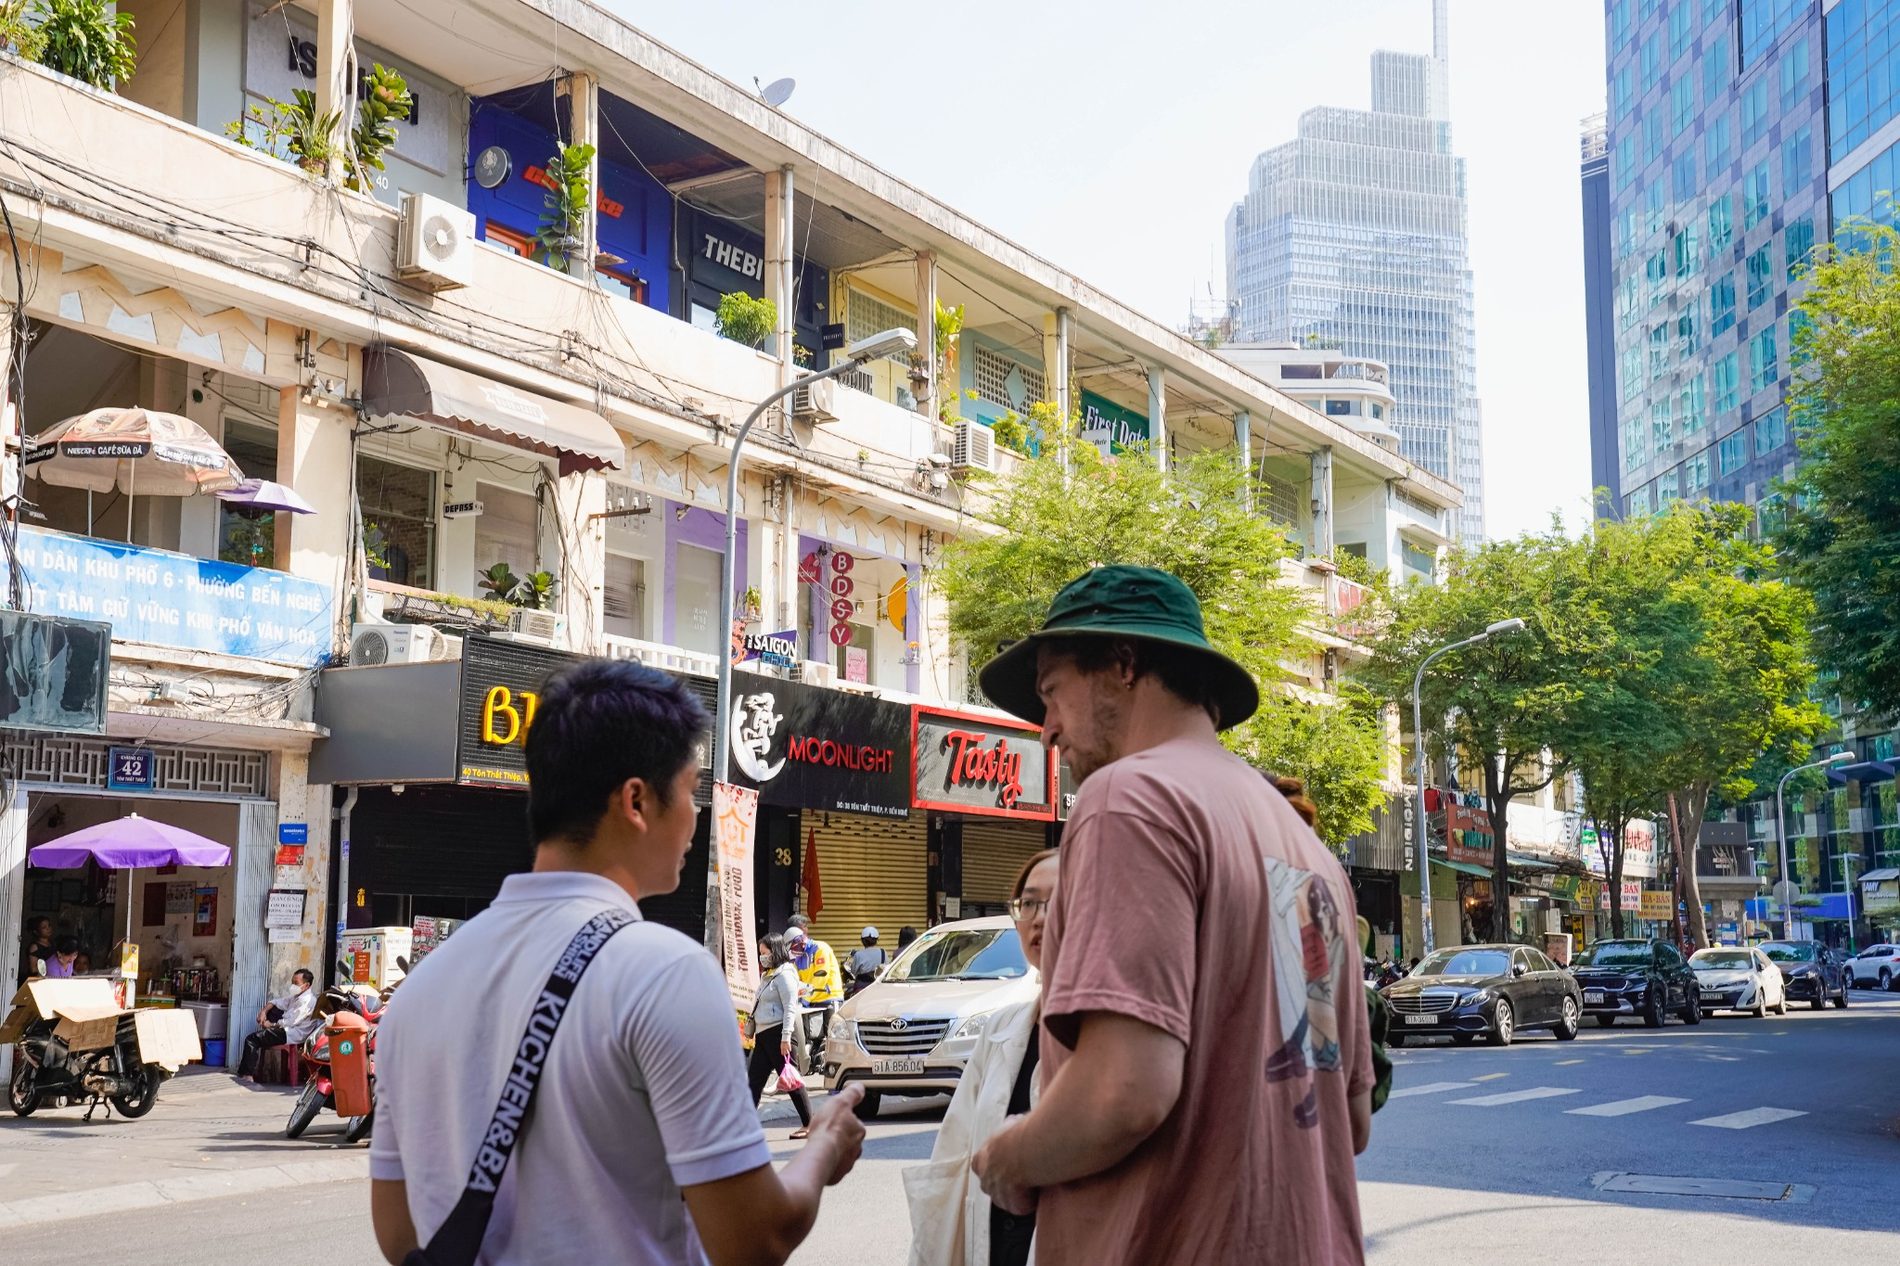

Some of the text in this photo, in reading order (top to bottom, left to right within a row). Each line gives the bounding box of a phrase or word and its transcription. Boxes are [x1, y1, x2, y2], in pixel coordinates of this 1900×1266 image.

[375, 175, 389, 189] 40
[704, 233, 763, 281] THEBI
[1085, 405, 1117, 441] First
[42, 552, 78, 574] DÂN
[85, 559, 119, 579] KHU
[126, 563, 159, 585] PHỐ
[163, 571, 174, 588] 6
[187, 574, 245, 601] PHƯỜNG
[57, 590, 94, 613] TÂM
[187, 610, 213, 630] KHU
[219, 615, 252, 638] PHỐ
[753, 634, 796, 661] SAIGON
[122, 761, 142, 776] 42
[788, 735, 895, 774] MOONLIGHT
[947, 730, 1023, 806] Tasty
[774, 847, 792, 866] 38
[467, 990, 568, 1194] KUCHEN&BA
